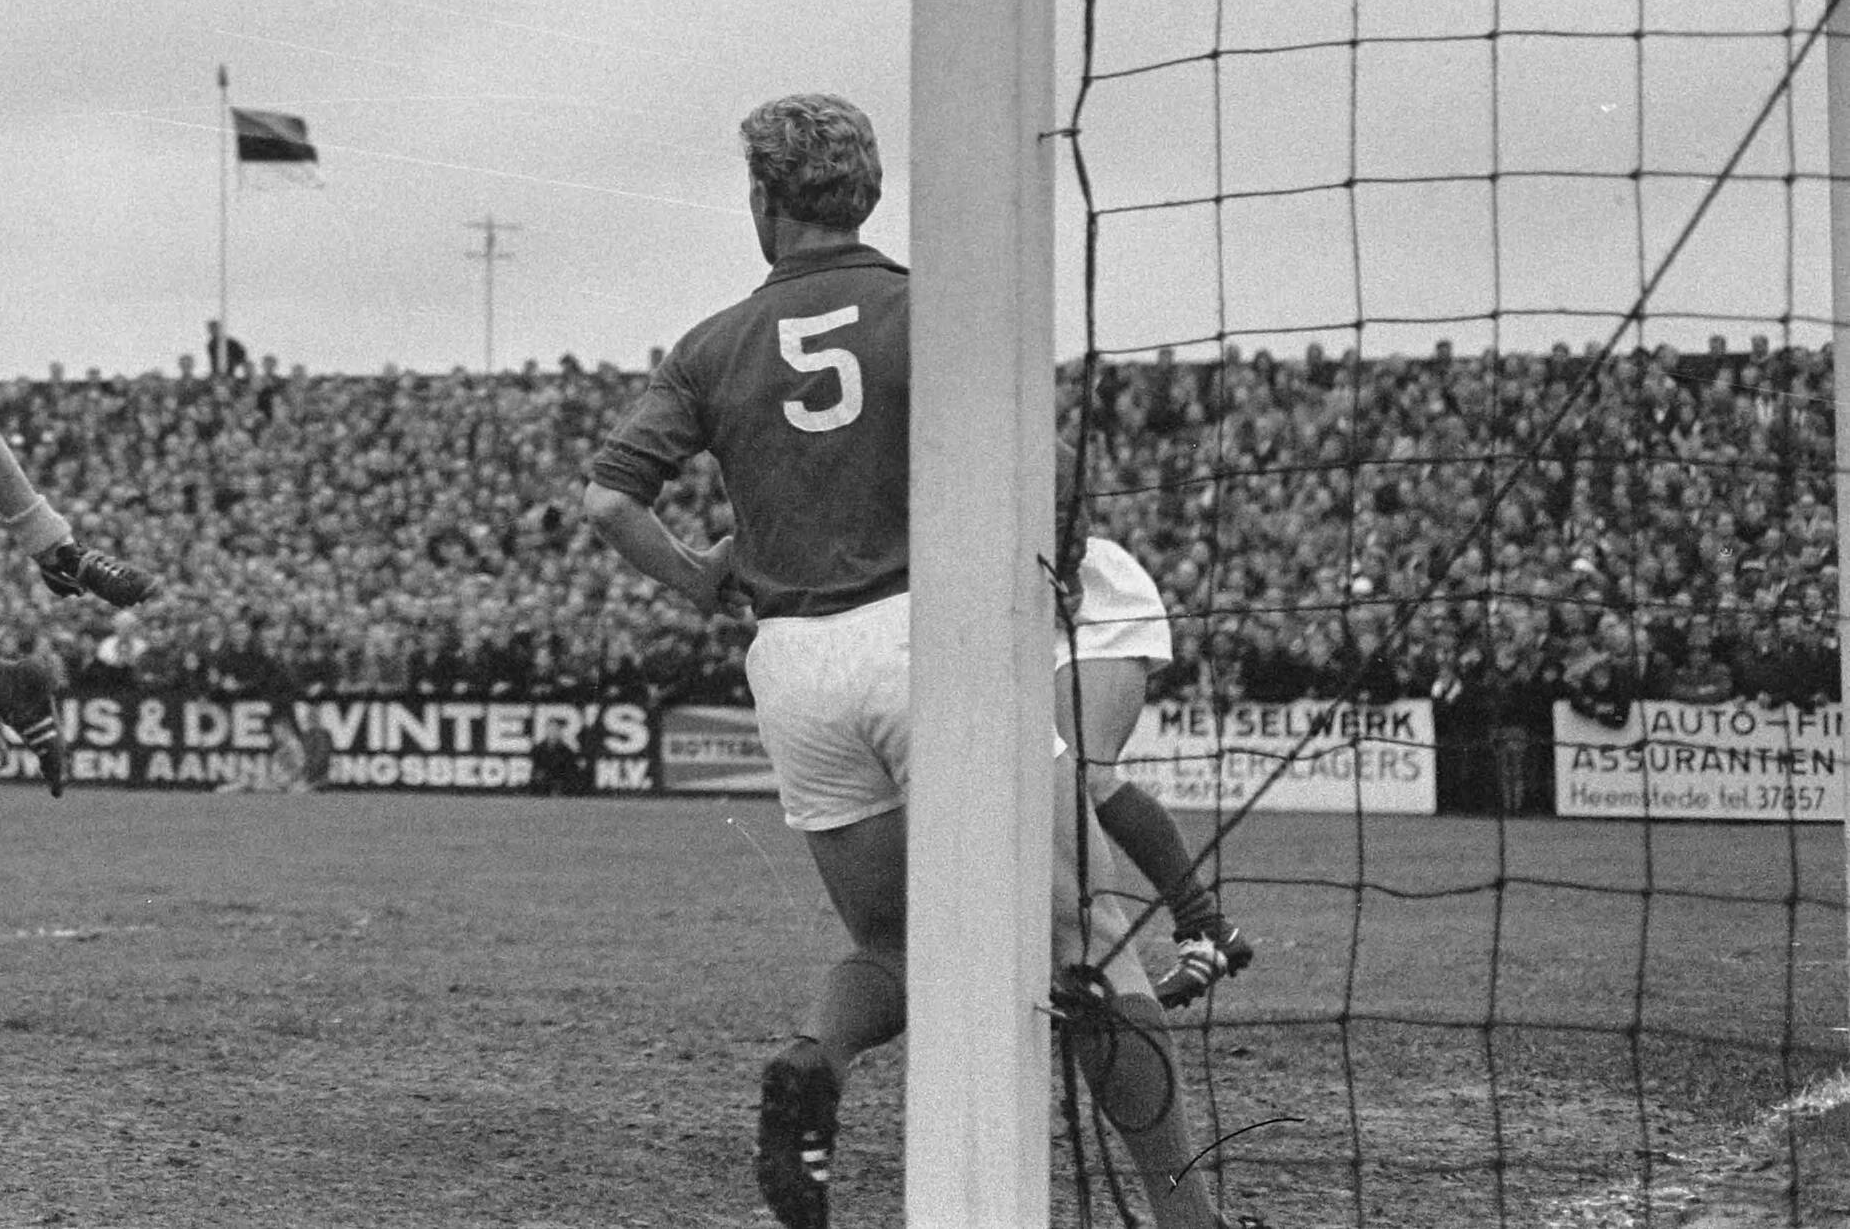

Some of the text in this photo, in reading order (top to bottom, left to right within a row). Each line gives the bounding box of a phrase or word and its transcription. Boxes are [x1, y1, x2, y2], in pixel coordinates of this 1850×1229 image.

[778, 304, 863, 432] 5
[183, 700, 273, 749] DE
[293, 700, 649, 755] WINTER'S
